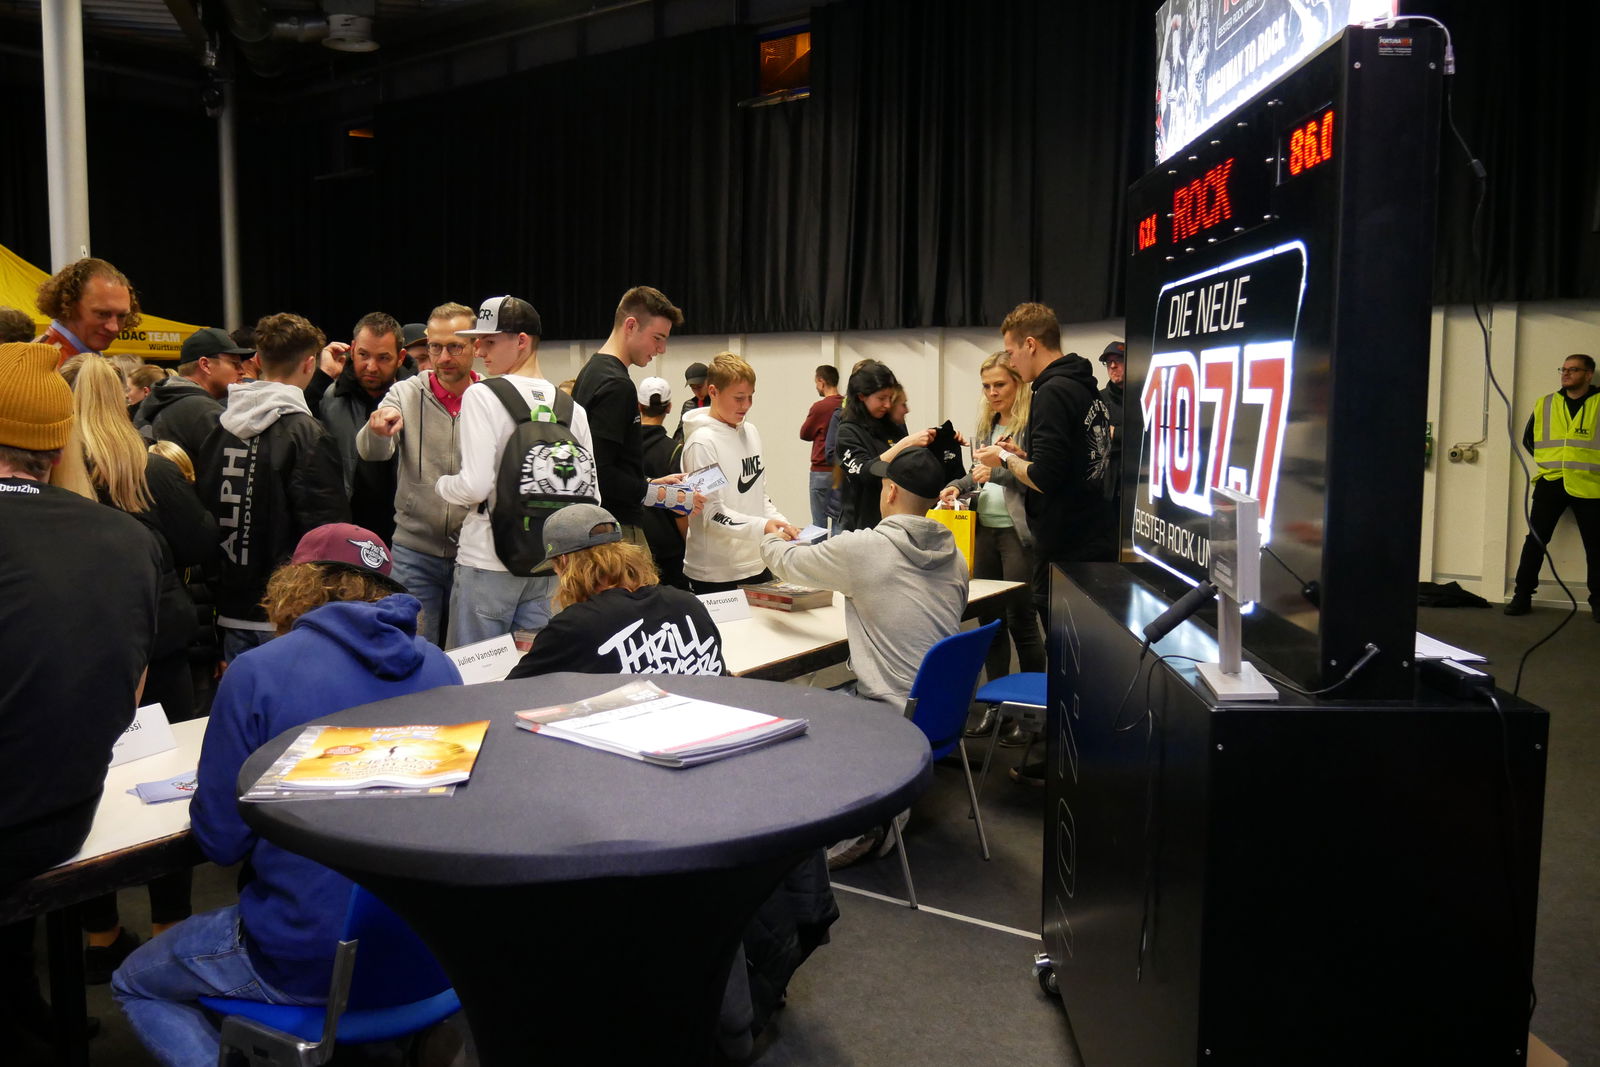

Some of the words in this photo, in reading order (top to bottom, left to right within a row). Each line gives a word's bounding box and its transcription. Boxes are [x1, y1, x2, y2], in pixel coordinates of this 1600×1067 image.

[1244, 39, 1256, 76] TO
[1257, 12, 1286, 67] ROCK
[1173, 157, 1234, 243] ROCK
[1167, 290, 1195, 339] DIE
[1195, 275, 1251, 334] NEUE
[147, 331, 180, 342] TEAM
[1140, 342, 1293, 542] 107.7
[741, 455, 761, 478] NIKE
[711, 512, 731, 526] NIKE
[1135, 508, 1166, 547] BESTER
[1168, 522, 1194, 562] ROCK
[1197, 535, 1211, 569] UN
[706, 597, 739, 606] Marcusson
[457, 655, 476, 667] Julien
[475, 646, 509, 661] Vanstippen
